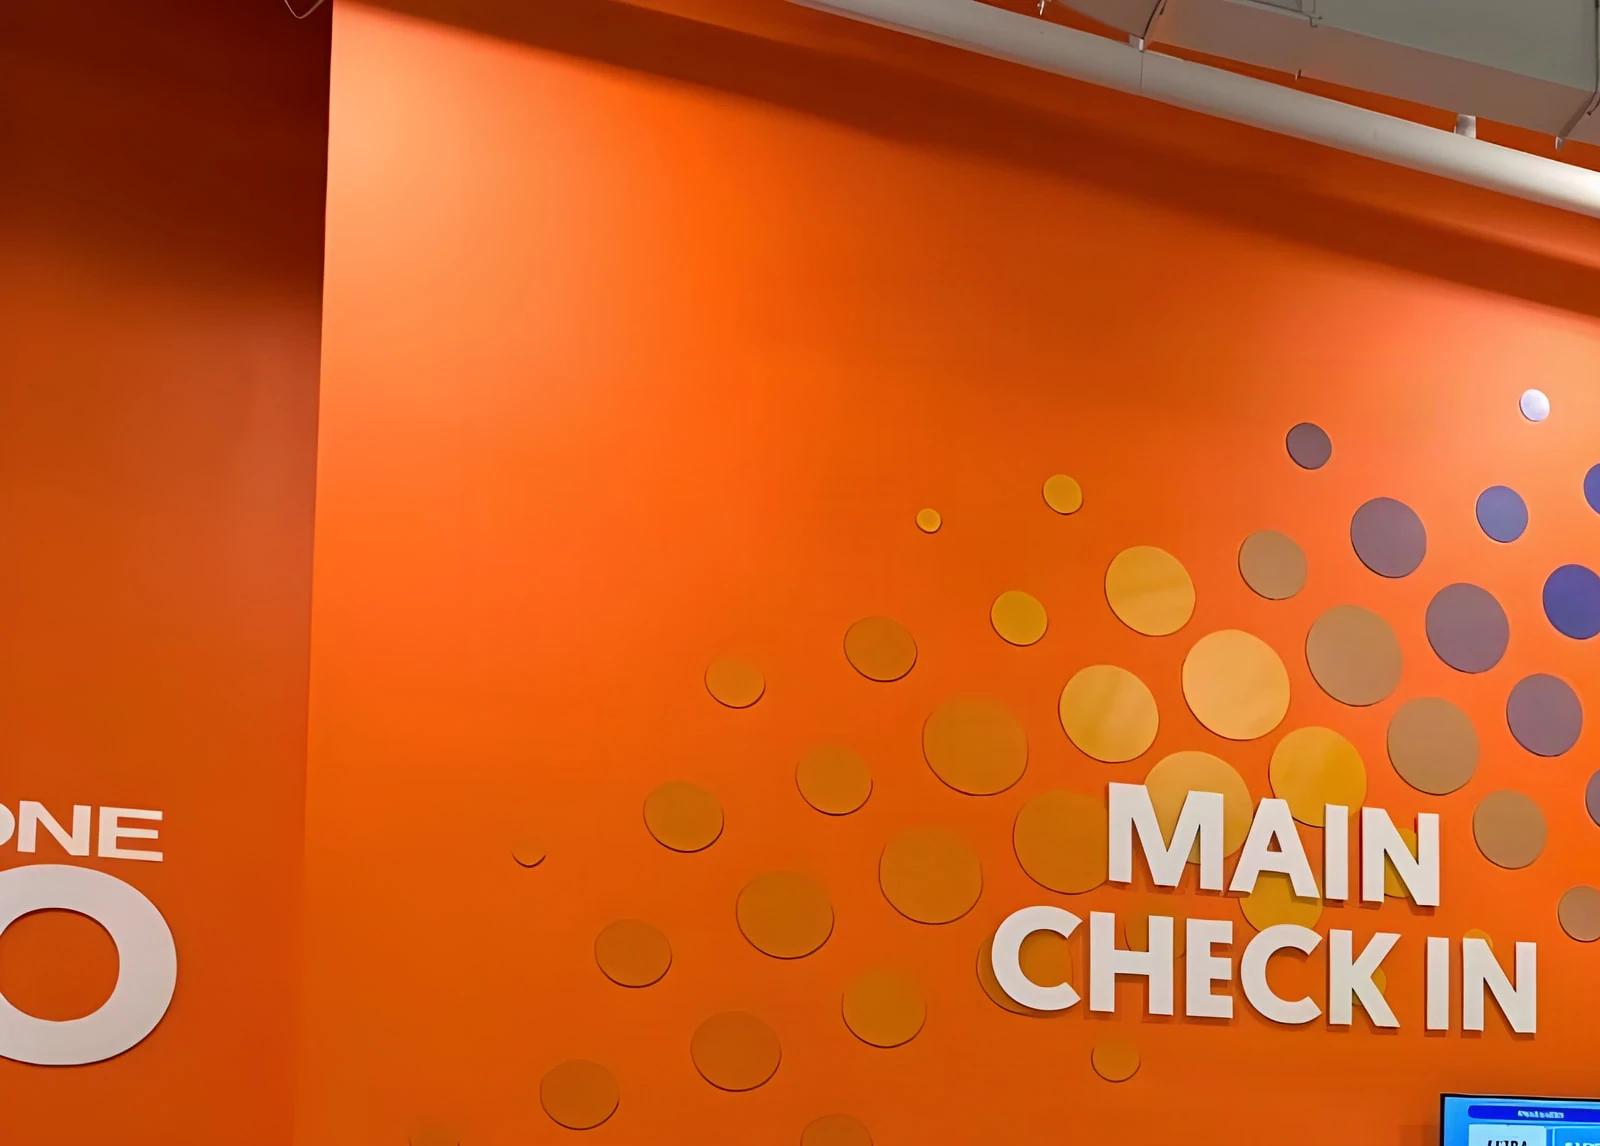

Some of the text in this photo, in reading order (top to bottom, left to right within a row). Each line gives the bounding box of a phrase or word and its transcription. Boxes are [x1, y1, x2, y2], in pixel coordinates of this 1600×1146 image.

[0, 800, 163, 862] NE
[1108, 782, 1439, 907] MAIN
[991, 906, 1537, 1033] CHECK IN
